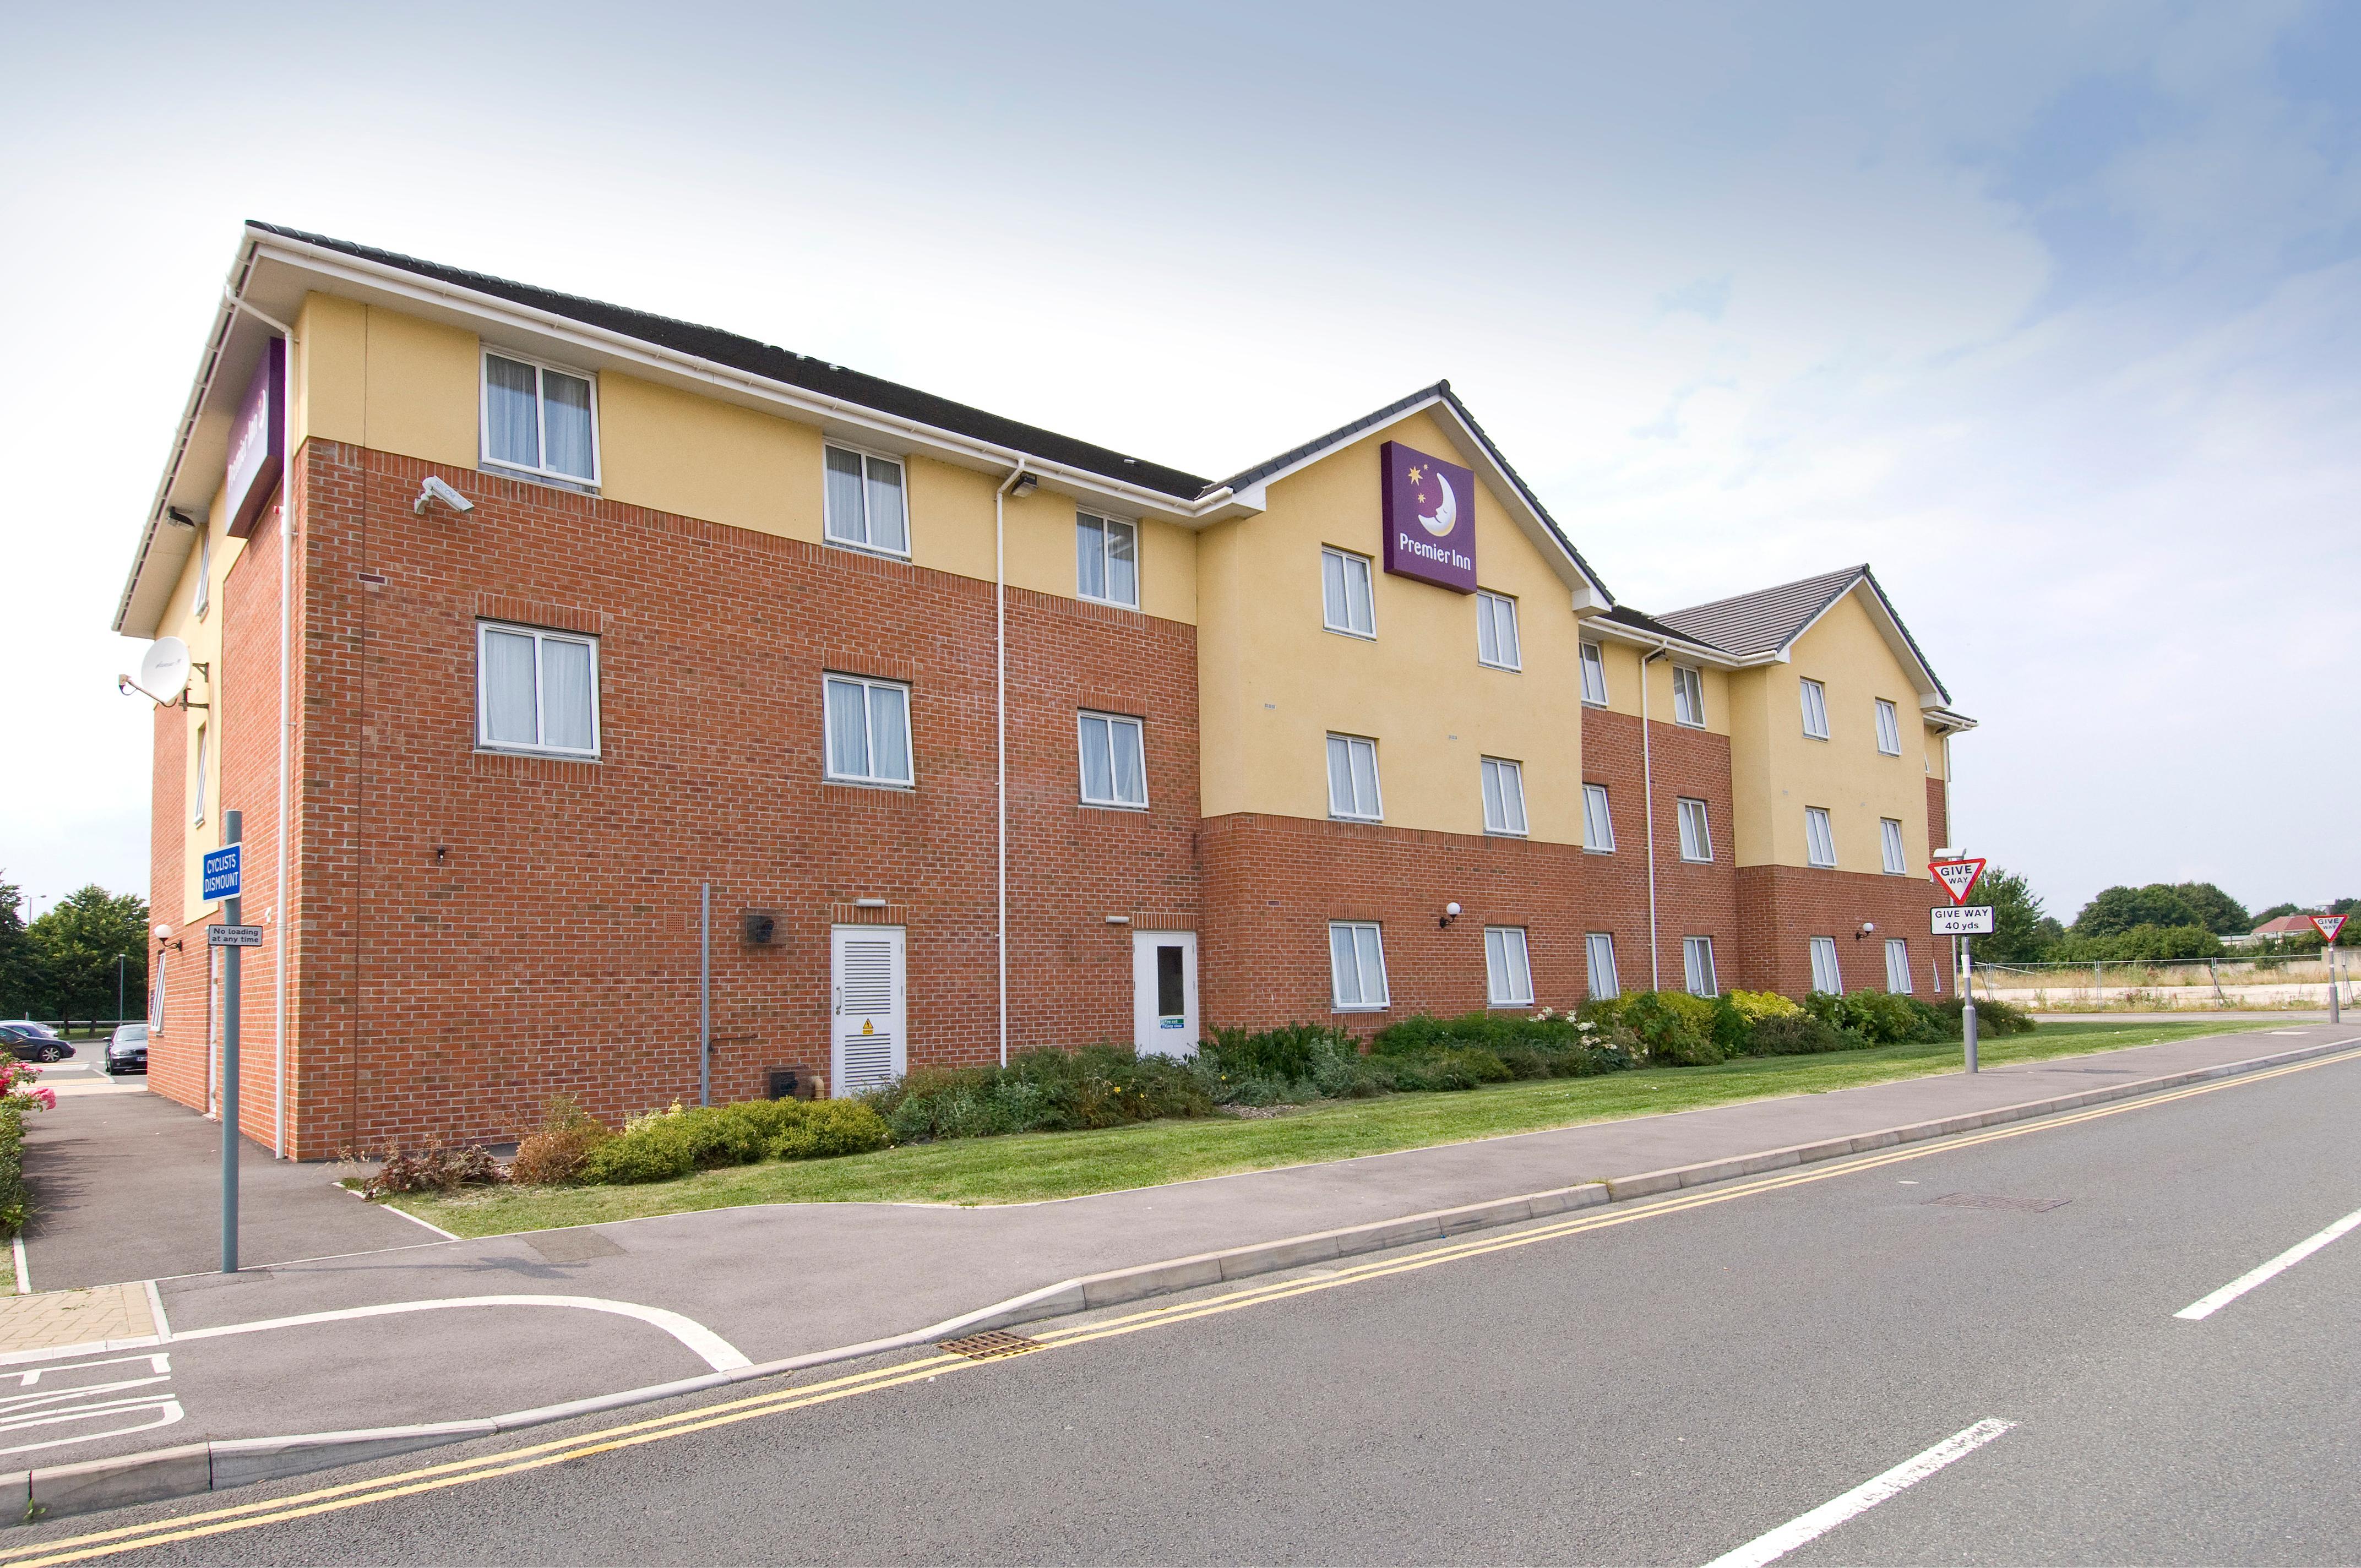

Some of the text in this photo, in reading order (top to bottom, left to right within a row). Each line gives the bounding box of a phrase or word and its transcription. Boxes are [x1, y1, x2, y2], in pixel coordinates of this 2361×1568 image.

[1400, 532, 1471, 570] Premier Inn
[207, 853, 236, 874] CYCLISTS
[1941, 865, 1972, 876] GIVE
[205, 872, 238, 892] DISMOUNT
[1964, 909, 1988, 917] WAY
[1962, 922, 1979, 930] yds
